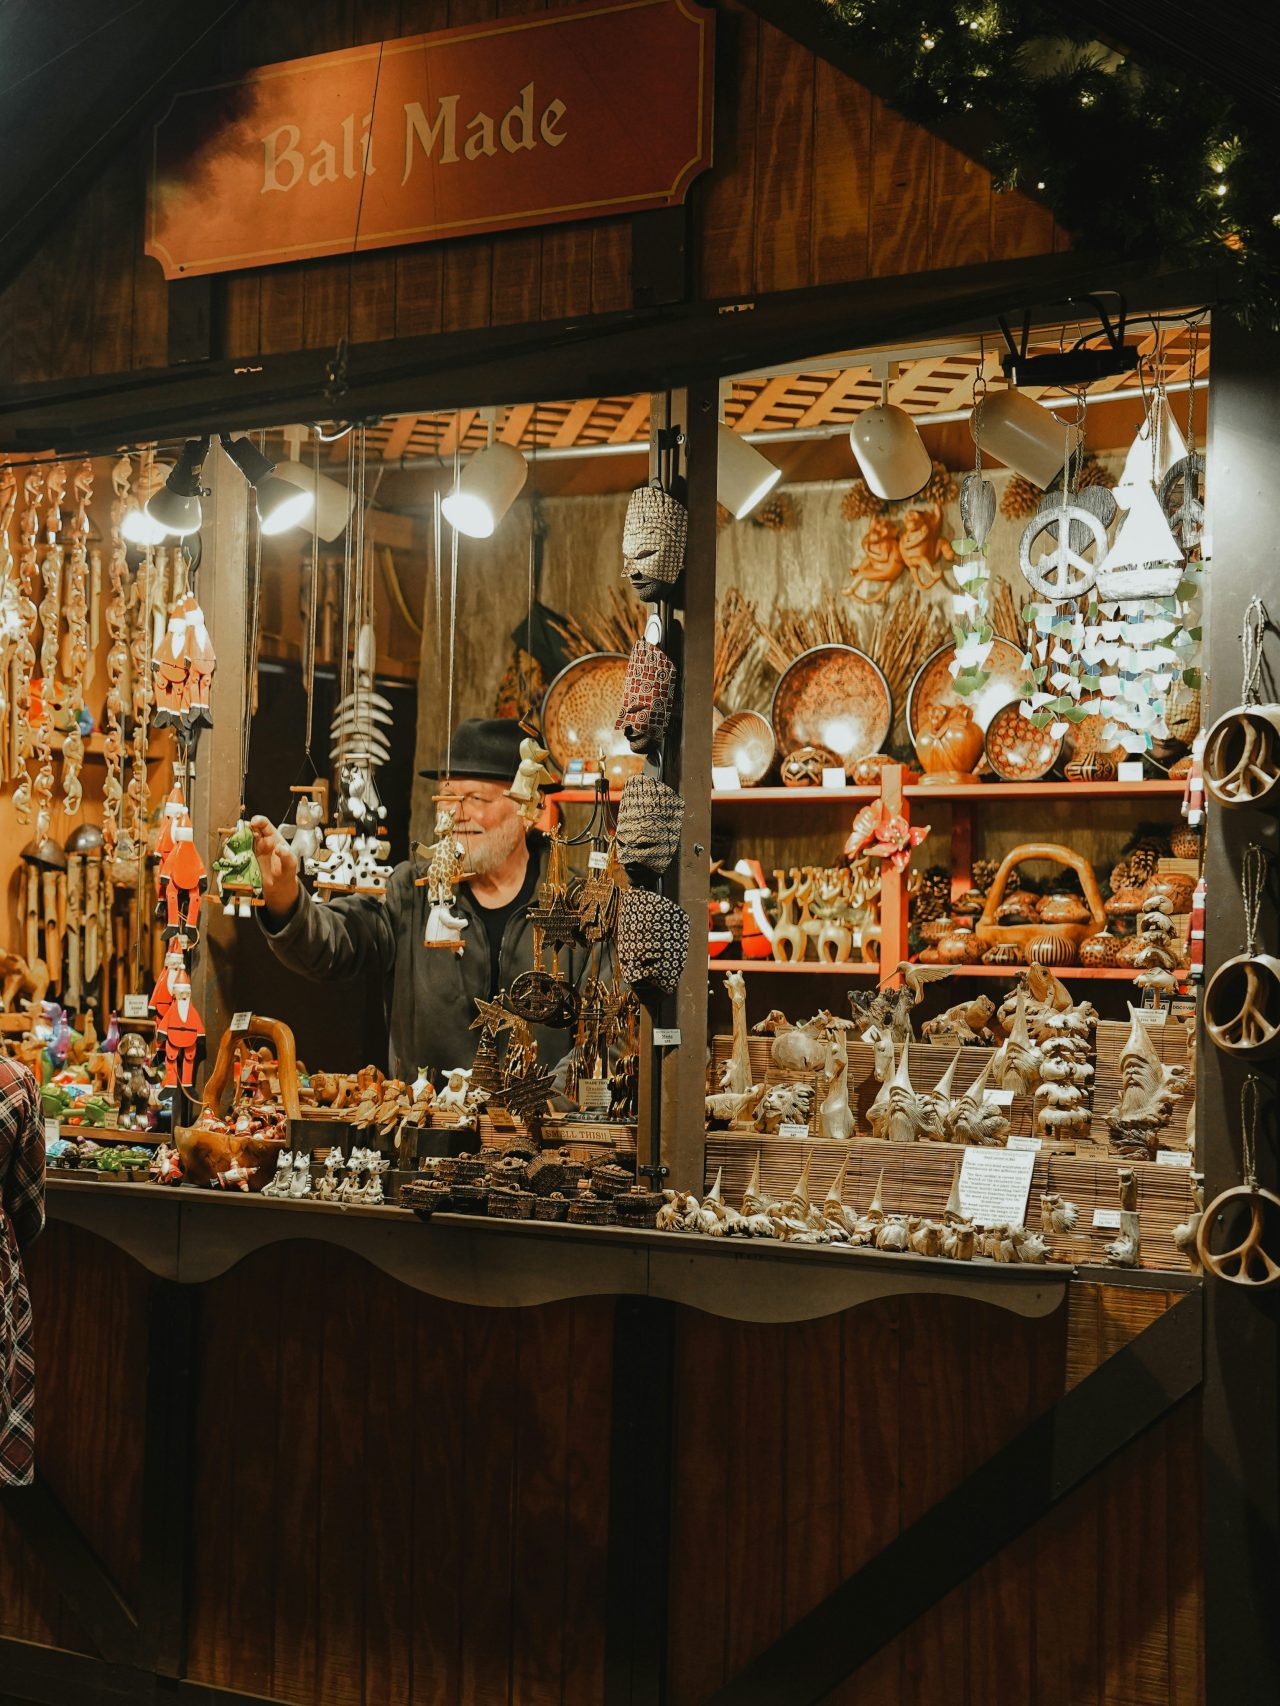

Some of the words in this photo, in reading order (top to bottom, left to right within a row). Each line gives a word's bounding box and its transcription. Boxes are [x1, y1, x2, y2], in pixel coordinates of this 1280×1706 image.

[260, 113, 377, 195] Bali
[401, 81, 568, 187] Made
[545, 1130, 577, 1139] SMELL
